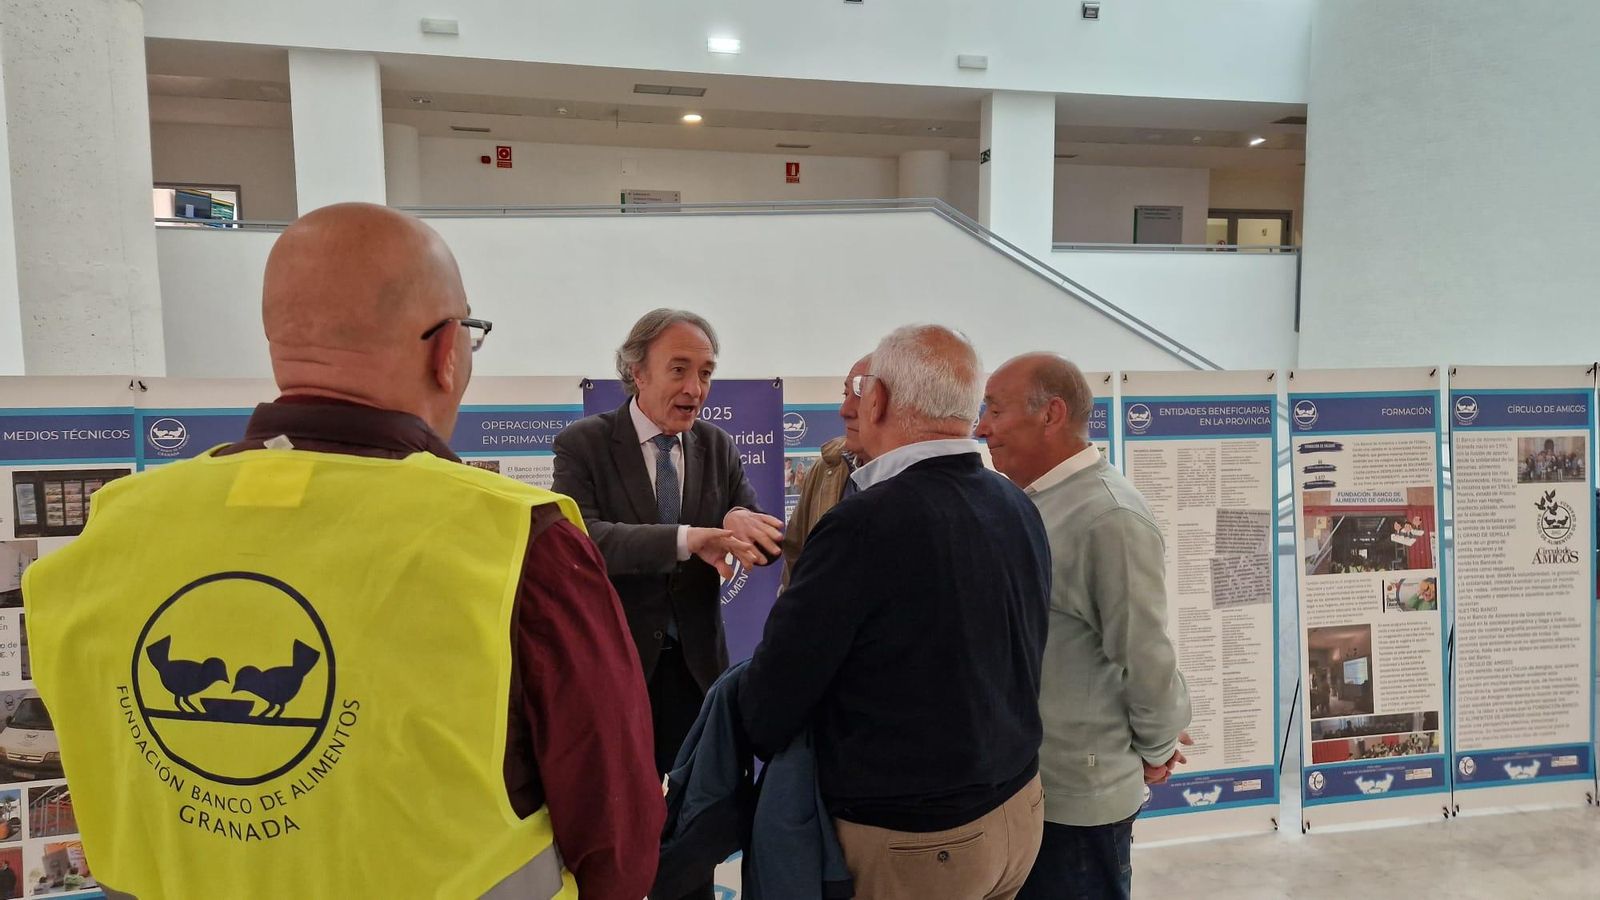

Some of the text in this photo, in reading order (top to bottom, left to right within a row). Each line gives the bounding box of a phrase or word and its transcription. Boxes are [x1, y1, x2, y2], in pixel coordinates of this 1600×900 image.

[1094, 410, 1106, 418] DE
[1159, 406, 1270, 416] ENTIDADES BENEFICIARIAS
[1381, 407, 1432, 416] FORMACIÓN
[1507, 404, 1586, 414] CÍRCULO DE AMIGOS
[481, 420, 563, 430] OPERACIONES
[1199, 416, 1271, 426] EN LA PROVINCIA
[3, 429, 131, 441] MEDIOS TÉCNICOS
[482, 435, 498, 445] EN
[1532, 550, 1579, 565] AMIGOS
[116, 685, 361, 814] FUNDACIÓN BANCO DE ALIMENTOS
[178, 804, 301, 842] GRANADA
